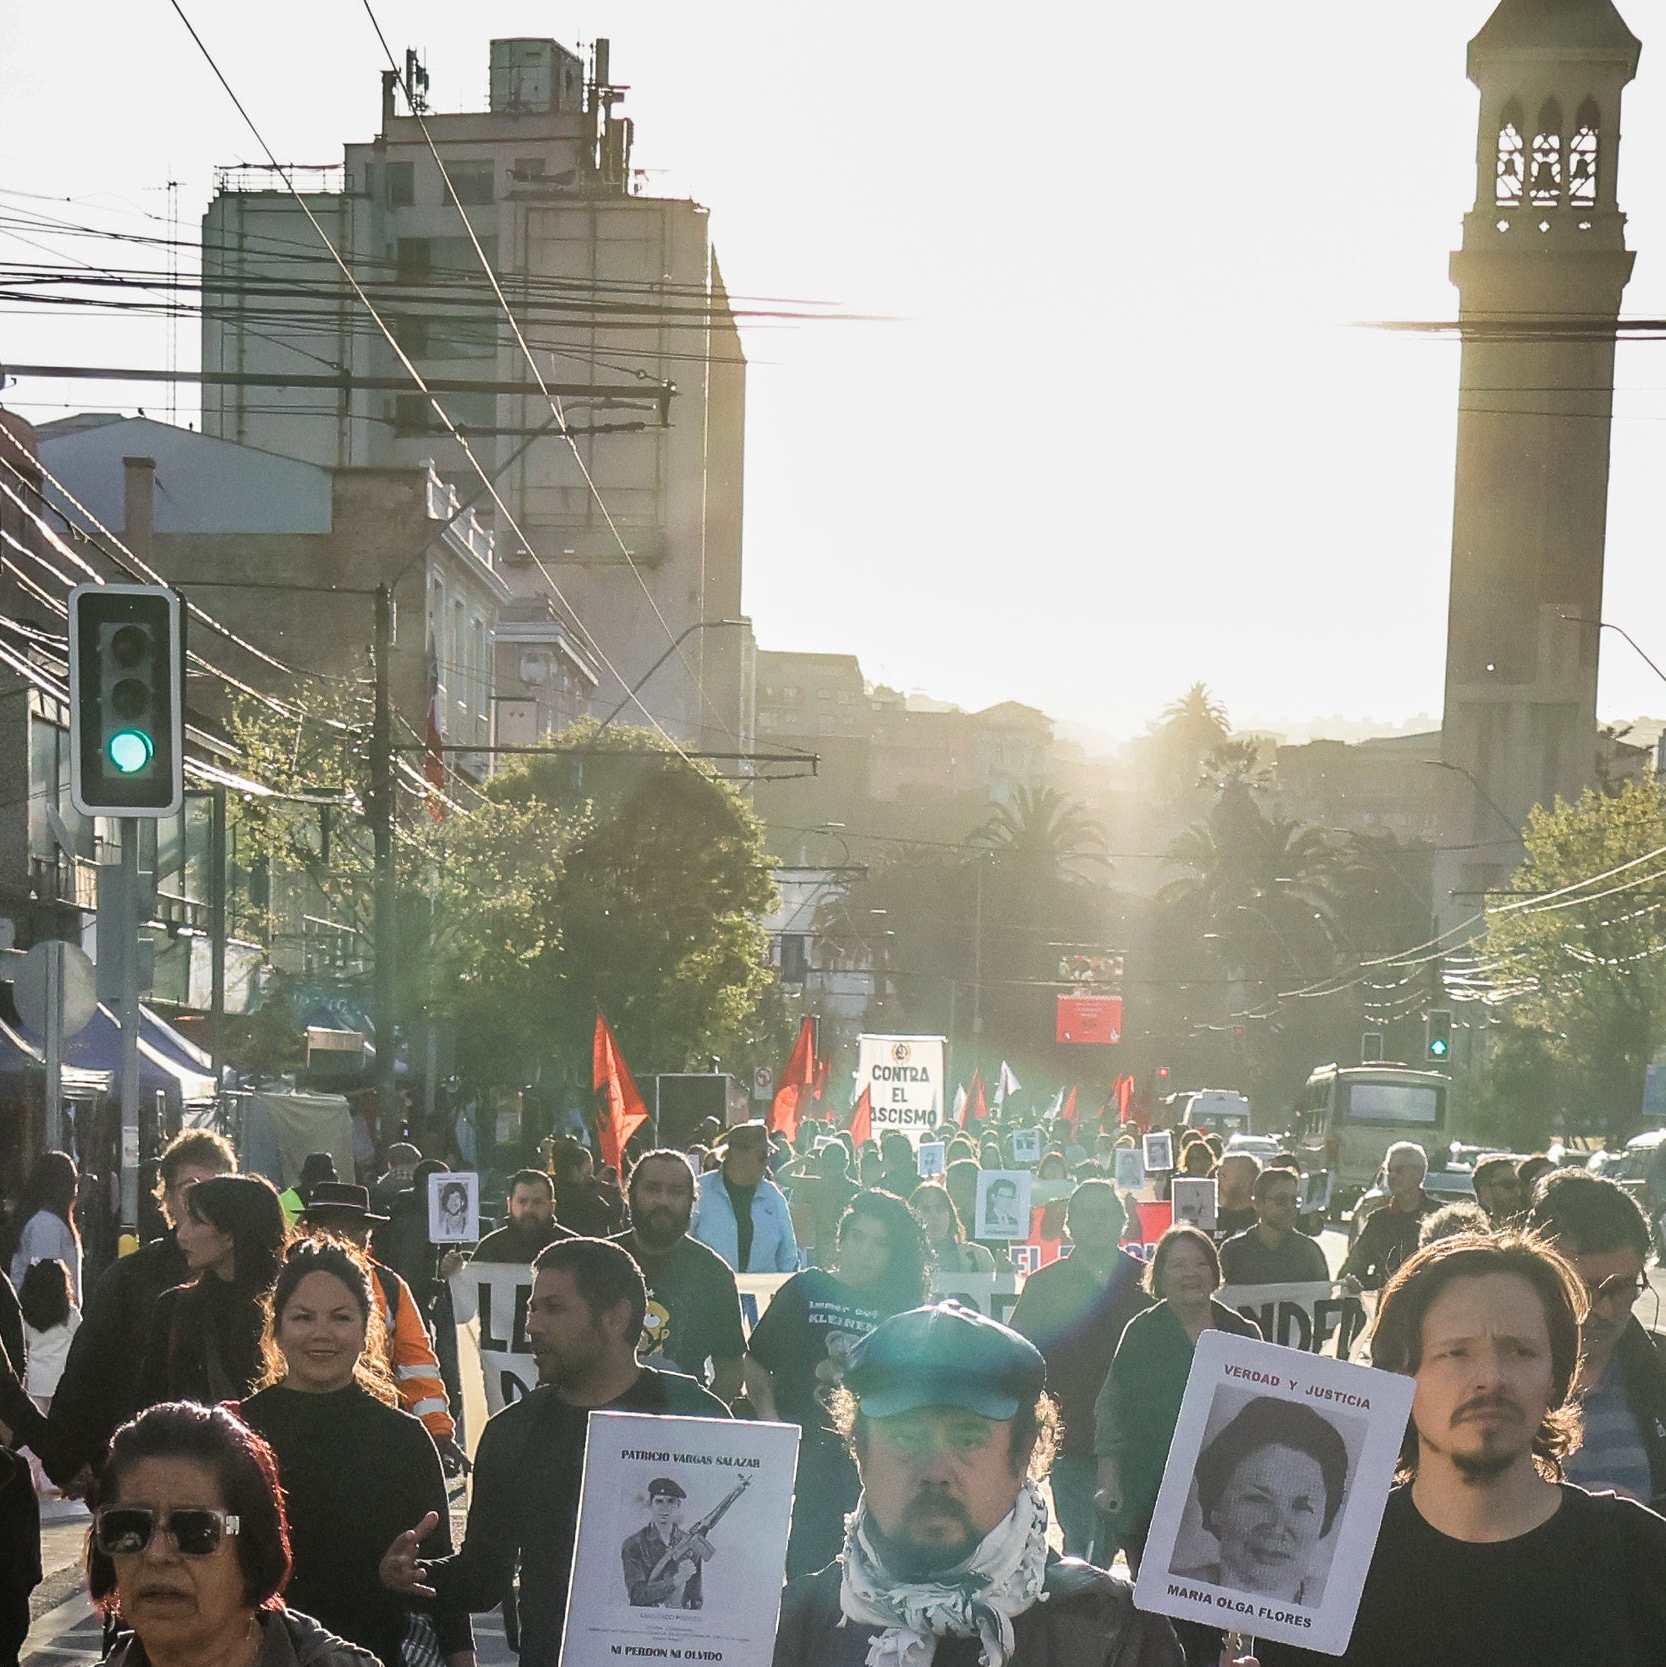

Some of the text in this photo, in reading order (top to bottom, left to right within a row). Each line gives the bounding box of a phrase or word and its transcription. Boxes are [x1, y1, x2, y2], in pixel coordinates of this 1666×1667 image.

[871, 1064, 930, 1082] CONTRA
[892, 1087, 908, 1103] EL
[869, 1107, 937, 1125] ASCISMO
[1224, 1364, 1371, 1410] VERDAD Y JUSTICIA
[621, 1450, 761, 1468] PATRICIO VARGAS SALAZAR
[1167, 1584, 1312, 1629] MARIA OLGA FLORES
[611, 1645, 622, 1655] NI
[670, 1649, 682, 1658] NI
[684, 1650, 723, 1661] OLVIDO
